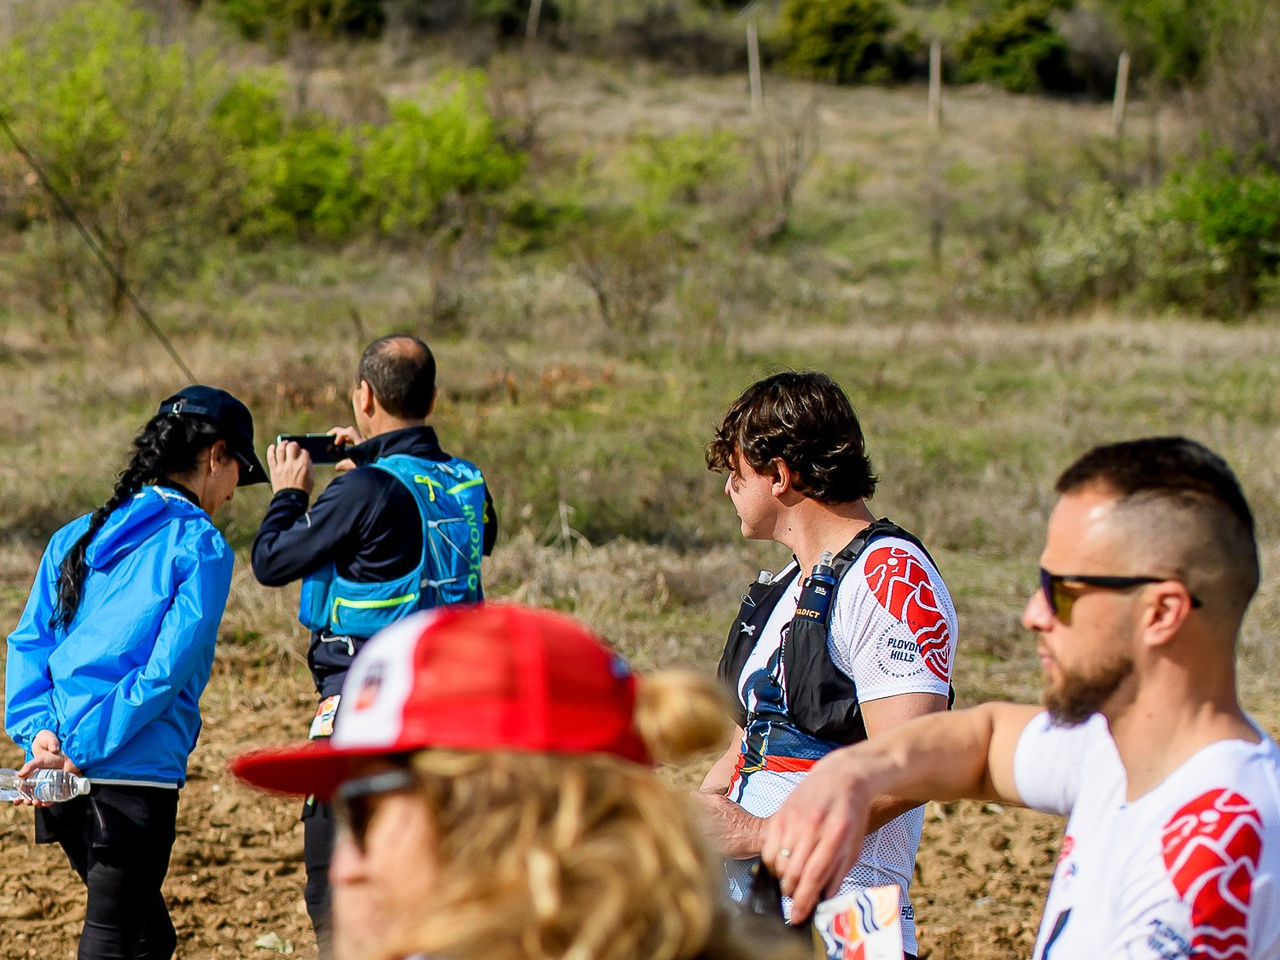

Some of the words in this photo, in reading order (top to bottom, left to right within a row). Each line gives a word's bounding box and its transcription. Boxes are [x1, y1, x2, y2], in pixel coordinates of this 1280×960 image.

[796, 608, 820, 618] ADICT
[887, 637, 924, 654] PLOVDIV
[890, 650, 916, 663] HILLS
